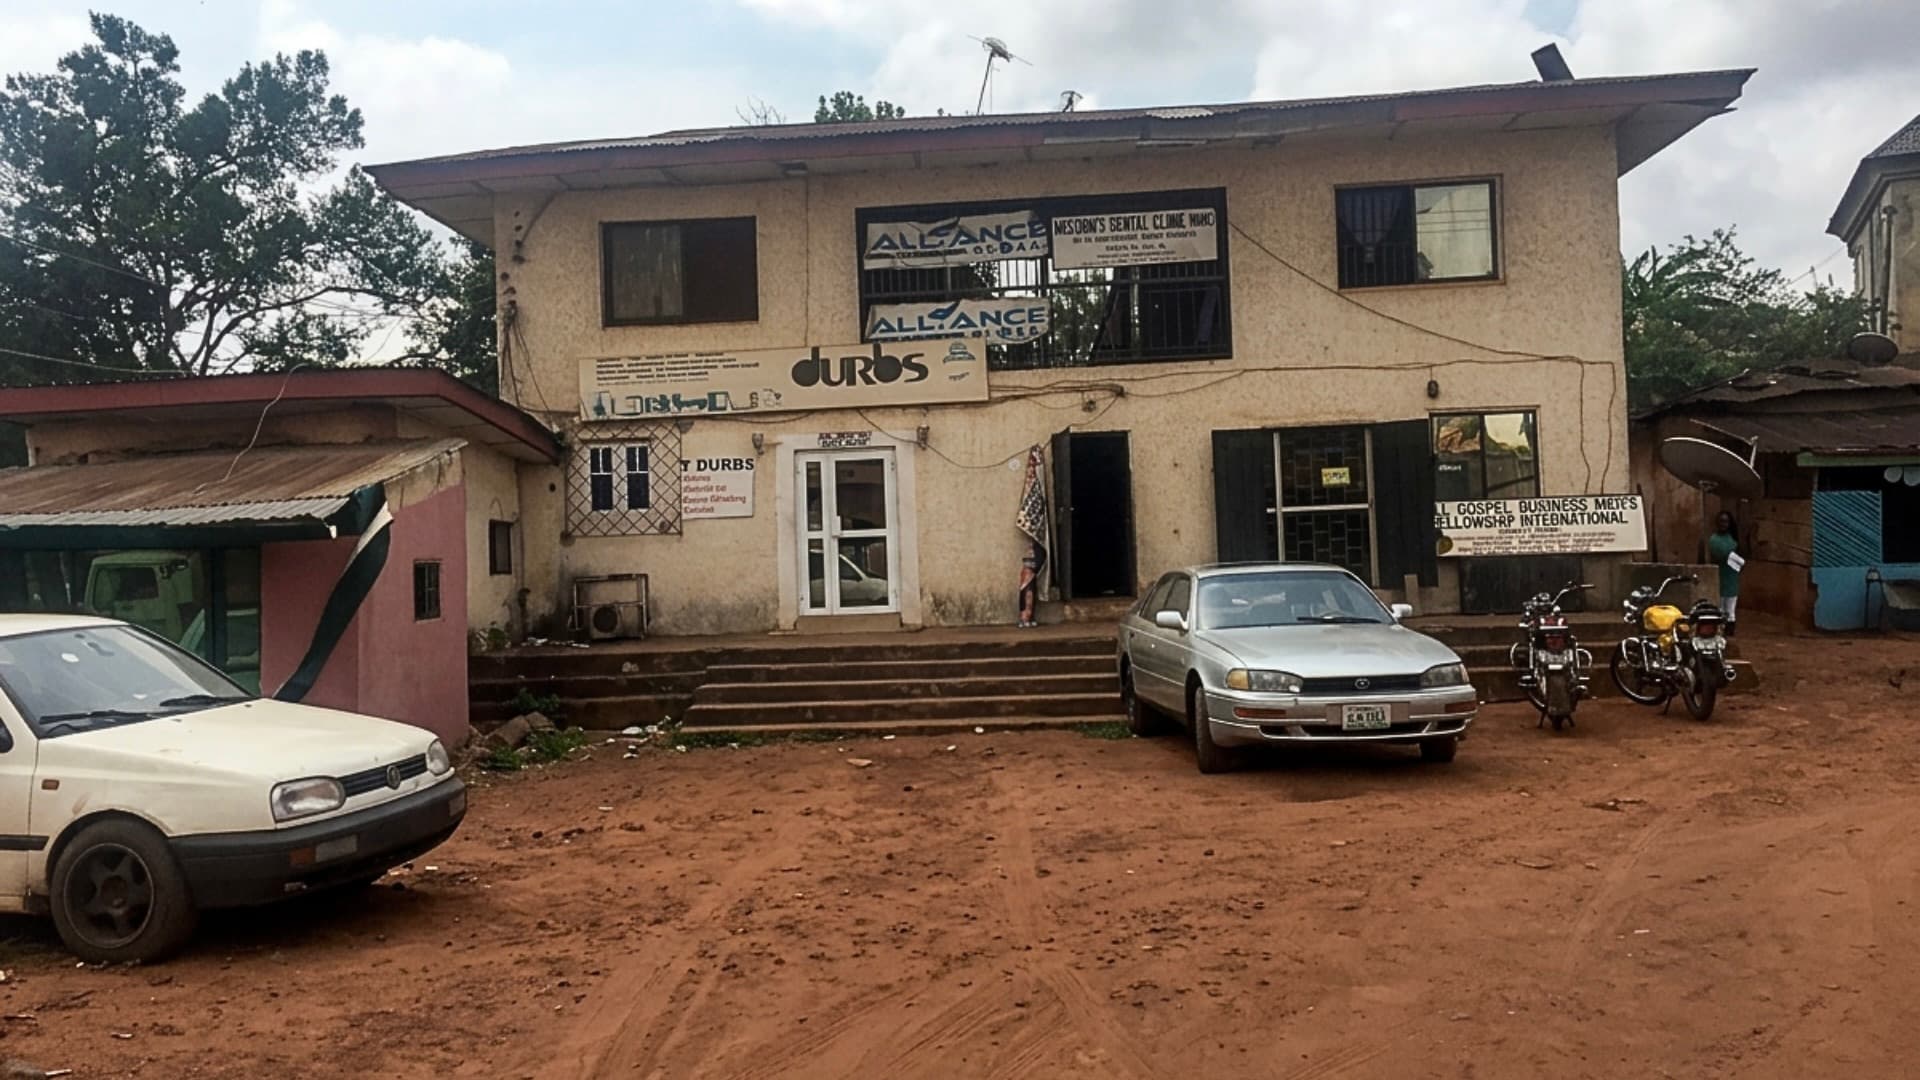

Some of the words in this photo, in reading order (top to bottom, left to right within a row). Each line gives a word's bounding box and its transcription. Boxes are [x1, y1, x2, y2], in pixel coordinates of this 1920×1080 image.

[696, 458, 754, 472] DURBS
[1457, 501, 1513, 516] GOSPEL
[1519, 498, 1588, 513] BUSINESS
